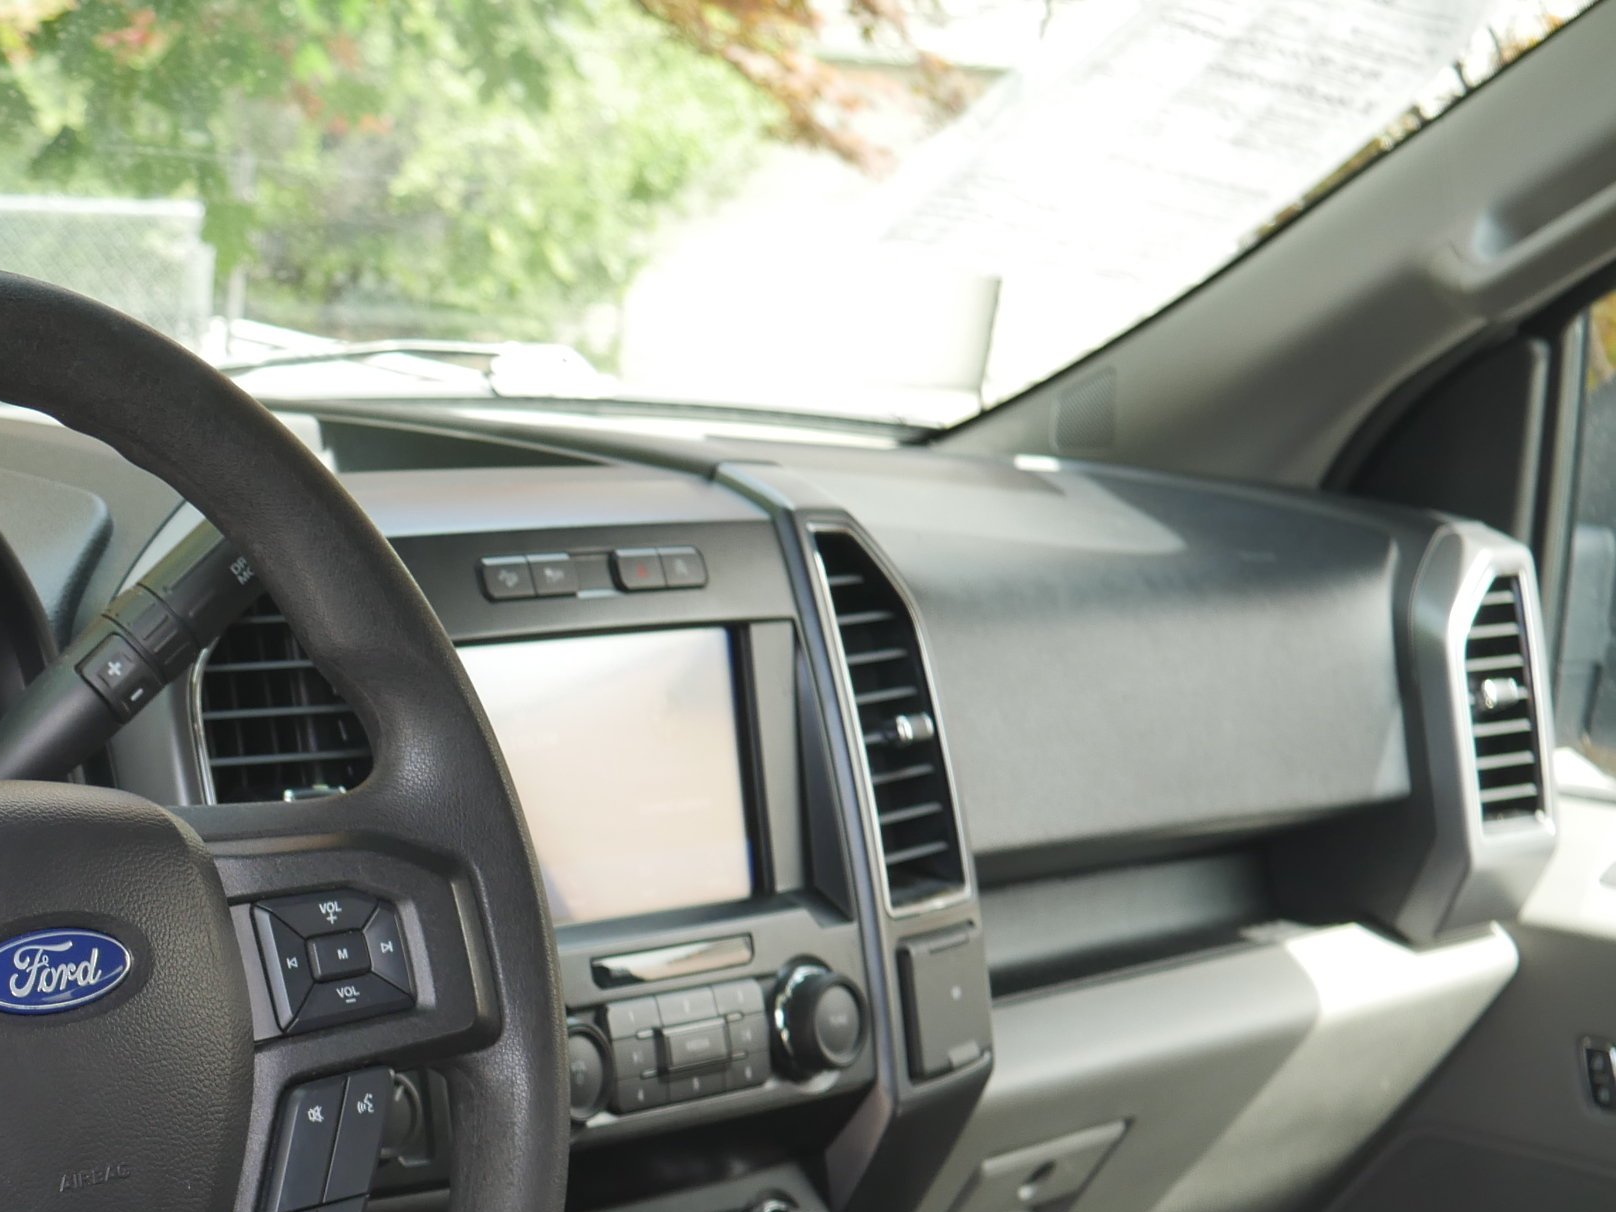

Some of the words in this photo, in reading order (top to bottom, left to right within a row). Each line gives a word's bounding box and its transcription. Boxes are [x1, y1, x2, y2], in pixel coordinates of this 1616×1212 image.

[318, 901, 342, 915] VOL
[338, 948, 349, 960] M
[9, 940, 102, 998] Ford
[336, 986, 360, 999] VOL
